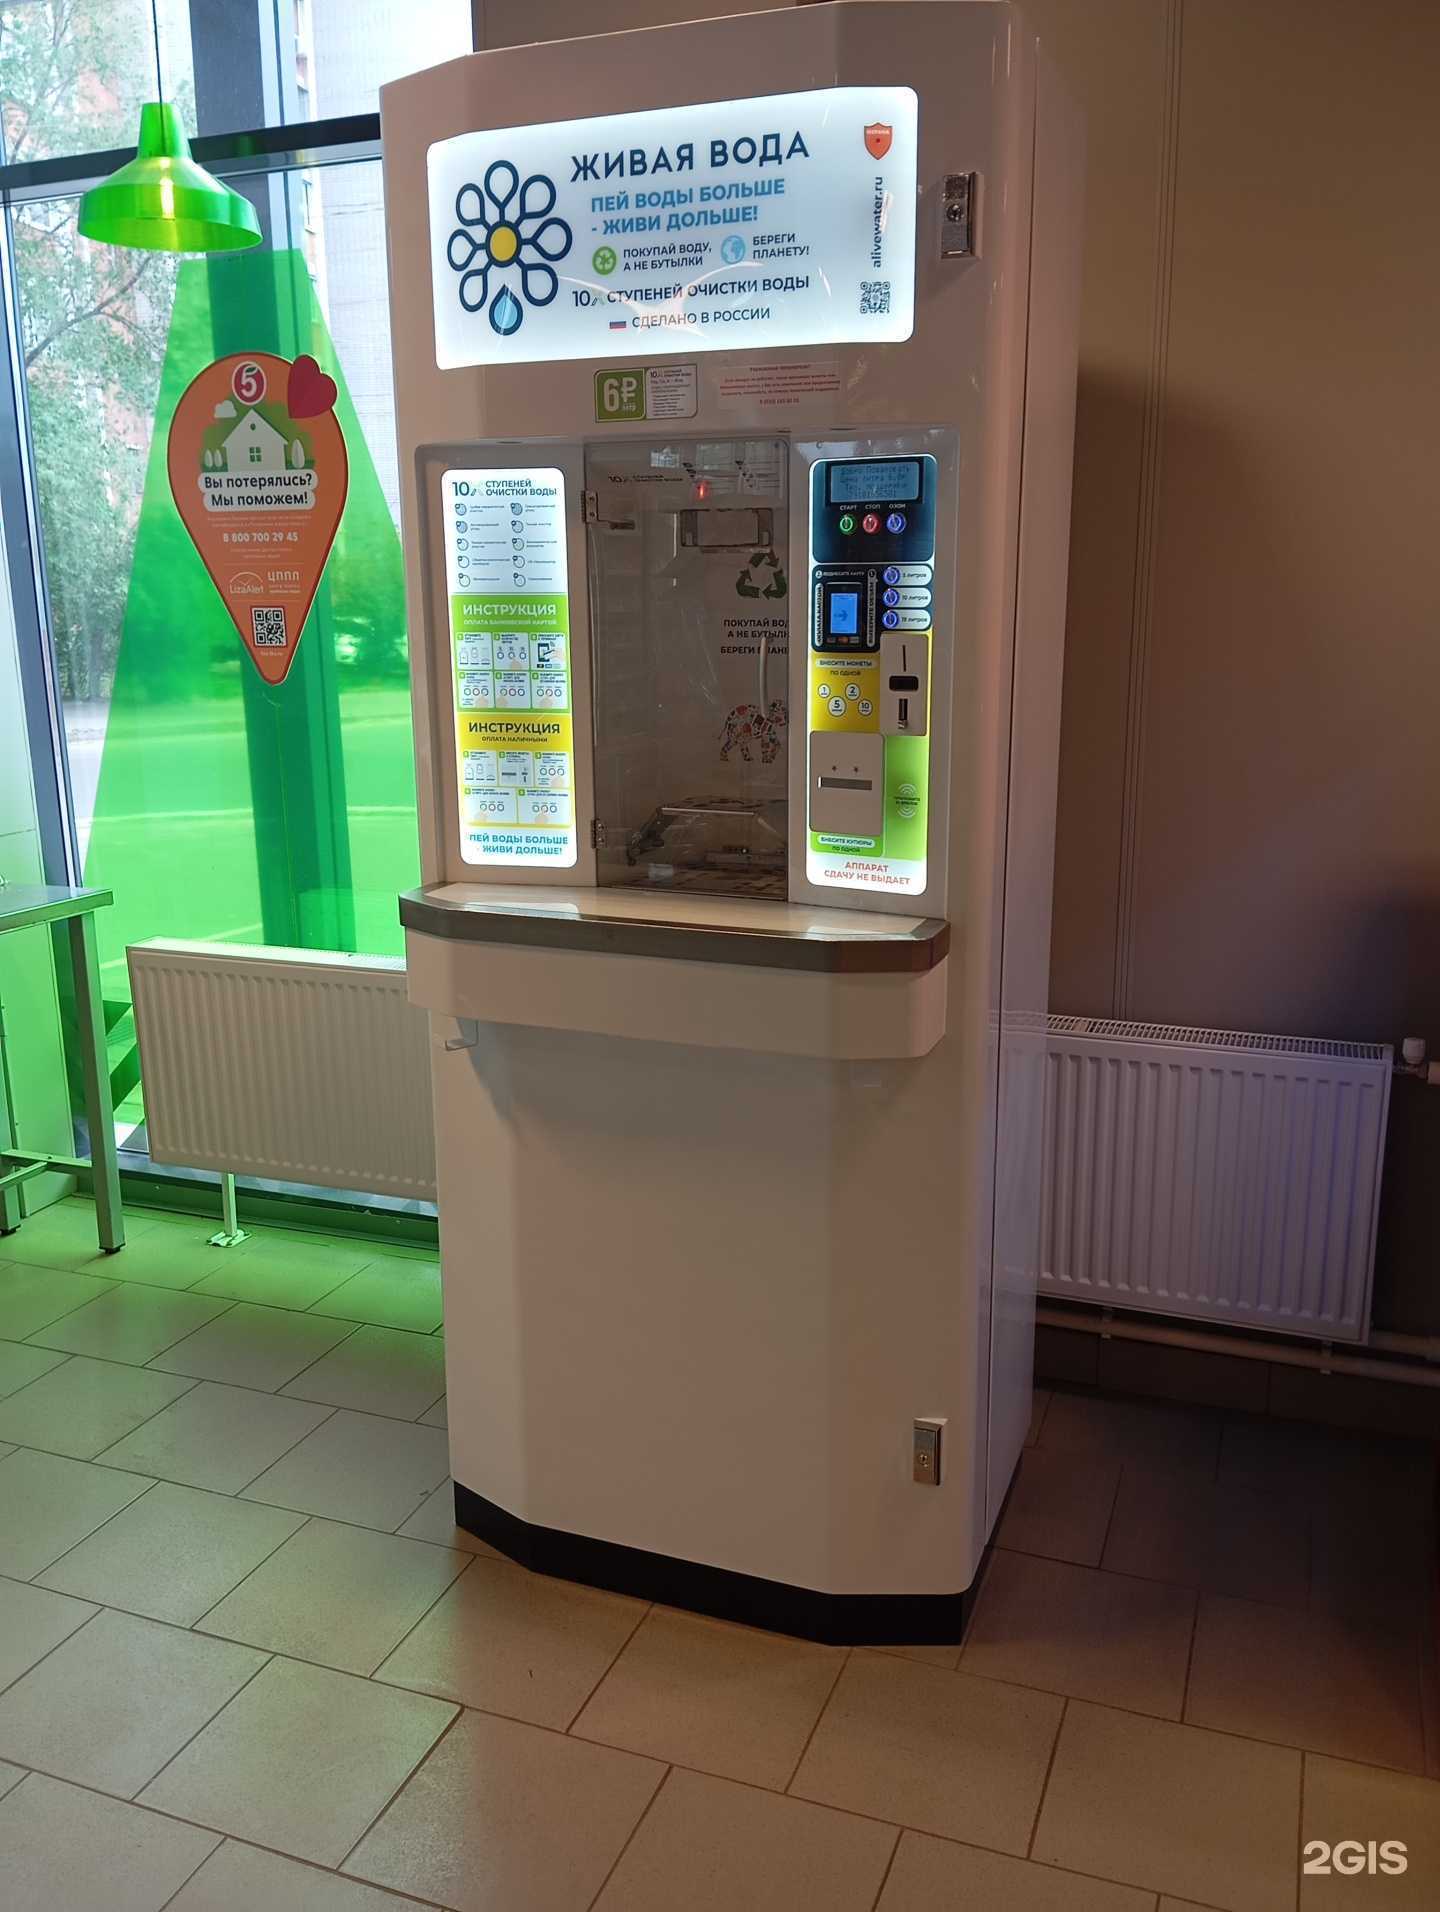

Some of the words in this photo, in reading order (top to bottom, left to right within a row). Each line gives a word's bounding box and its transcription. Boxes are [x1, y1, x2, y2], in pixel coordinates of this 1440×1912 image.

[570, 143, 694, 182] ЖИВАЯ
[710, 130, 810, 168] ВОДА
[591, 191, 629, 213] ПЕЙ
[635, 188, 693, 209] ВОДЫ
[699, 178, 785, 202] БОЛЬШЕ
[602, 215, 661, 235] ЖИВИ
[666, 205, 758, 232] ДОЛЬШЕ!
[870, 176, 883, 268] alivewater.ru
[752, 233, 796, 246] БЕРЕГИ
[623, 243, 676, 258] ПОКУПАЙ
[679, 242, 712, 254] ВОДУ,
[752, 246, 810, 260] ПЛАНЕТУ!
[623, 263, 631, 272] А
[633, 262, 648, 271] НЕ
[651, 256, 703, 269] БУТЫЛКИ
[572, 290, 591, 307] 10
[607, 283, 683, 303] СТУПЕНЕЙ
[687, 279, 758, 297] ОЧИСТКИ
[762, 276, 810, 292] ВОДЫ
[632, 312, 697, 330] СДЕЛАНО
[701, 312, 710, 323] В
[713, 308, 770, 323] РОССИИ
[204, 476, 222, 489] Вы
[227, 473, 312, 490] потерялись?
[452, 482, 470, 496] 10
[485, 478, 532, 488] СТУПЕНЕЙ
[211, 493, 233, 506] Мы
[237, 491, 308, 506] поможем!
[530, 488, 557, 496] ВОДЫ
[463, 604, 556, 616] ИНСТРУКЦИЯ
[724, 618, 769, 627] ПОКУПАЙ
[772, 620, 787, 628] ВО
[720, 646, 755, 654] БЕРЕГИ
[834, 700, 840, 708] 5
[469, 722, 560, 735] ИНСТРУКЦИЯ
[469, 833, 489, 842] ПЕЙ
[492, 835, 523, 844] ВОДЫ
[525, 836, 568, 845] БОЛЬШЕ
[482, 845, 513, 853] ЖИВИ
[515, 846, 563, 855] ДОЛЬШЕ!
[845, 862, 889, 873] АППАРАТ
[824, 870, 855, 879] СДАЧУ
[857, 873, 869, 881] НЕ
[871, 874, 911, 885] ВЫДАЕТ
